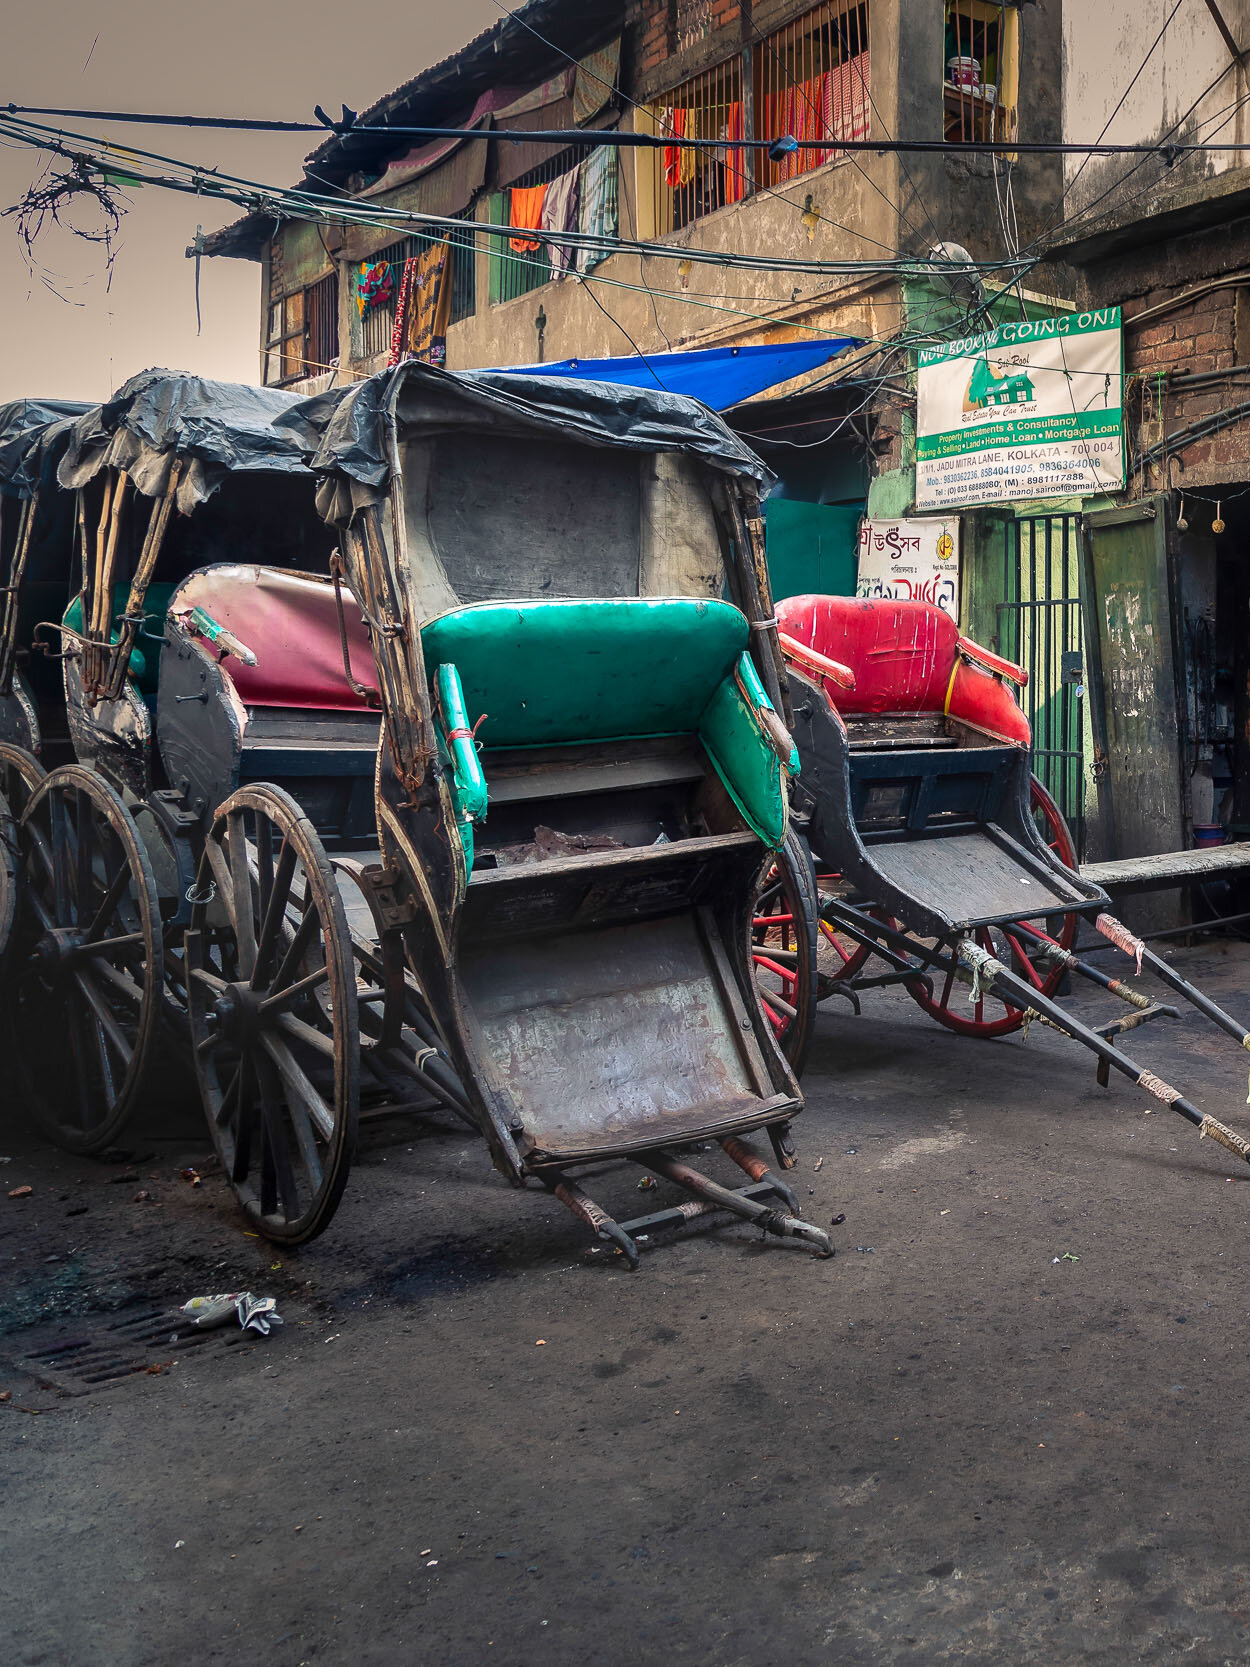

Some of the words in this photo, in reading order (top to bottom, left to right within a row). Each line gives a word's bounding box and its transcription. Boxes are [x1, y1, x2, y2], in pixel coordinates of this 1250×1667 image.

[919, 346, 946, 365] NOW
[949, 332, 999, 354] BOOKING
[1003, 317, 1070, 341] GOING
[1077, 309, 1116, 328] ON!
[988, 407, 1000, 419] You
[1003, 406, 1017, 416] Can
[1019, 403, 1037, 413] Trust
[917, 449, 936, 458] Buying
[937, 447, 941, 455] &
[943, 443, 961, 454] Selling
[966, 440, 980, 449] Land
[986, 435, 1010, 445] Home
[1013, 433, 1036, 442] Loan
[1045, 427, 1091, 439] Mortgage
[1094, 424, 1119, 433] Loan
[939, 433, 962, 443] Property
[964, 424, 1004, 438] Investments
[1007, 423, 1014, 431] &
[1017, 417, 1077, 431] Consultancy
[937, 462, 955, 472] JADU
[956, 457, 977, 468] MITRA
[1007, 447, 1061, 461] KOLKATA
[1071, 444, 1090, 455] 700
[1094, 442, 1114, 453] 004
[1039, 458, 1101, 471] 9836364006
[957, 485, 967, 493] 033
[1005, 479, 1019, 488] (M)
[1027, 472, 1084, 485] 8981117888
[982, 490, 1003, 499] E-mail
